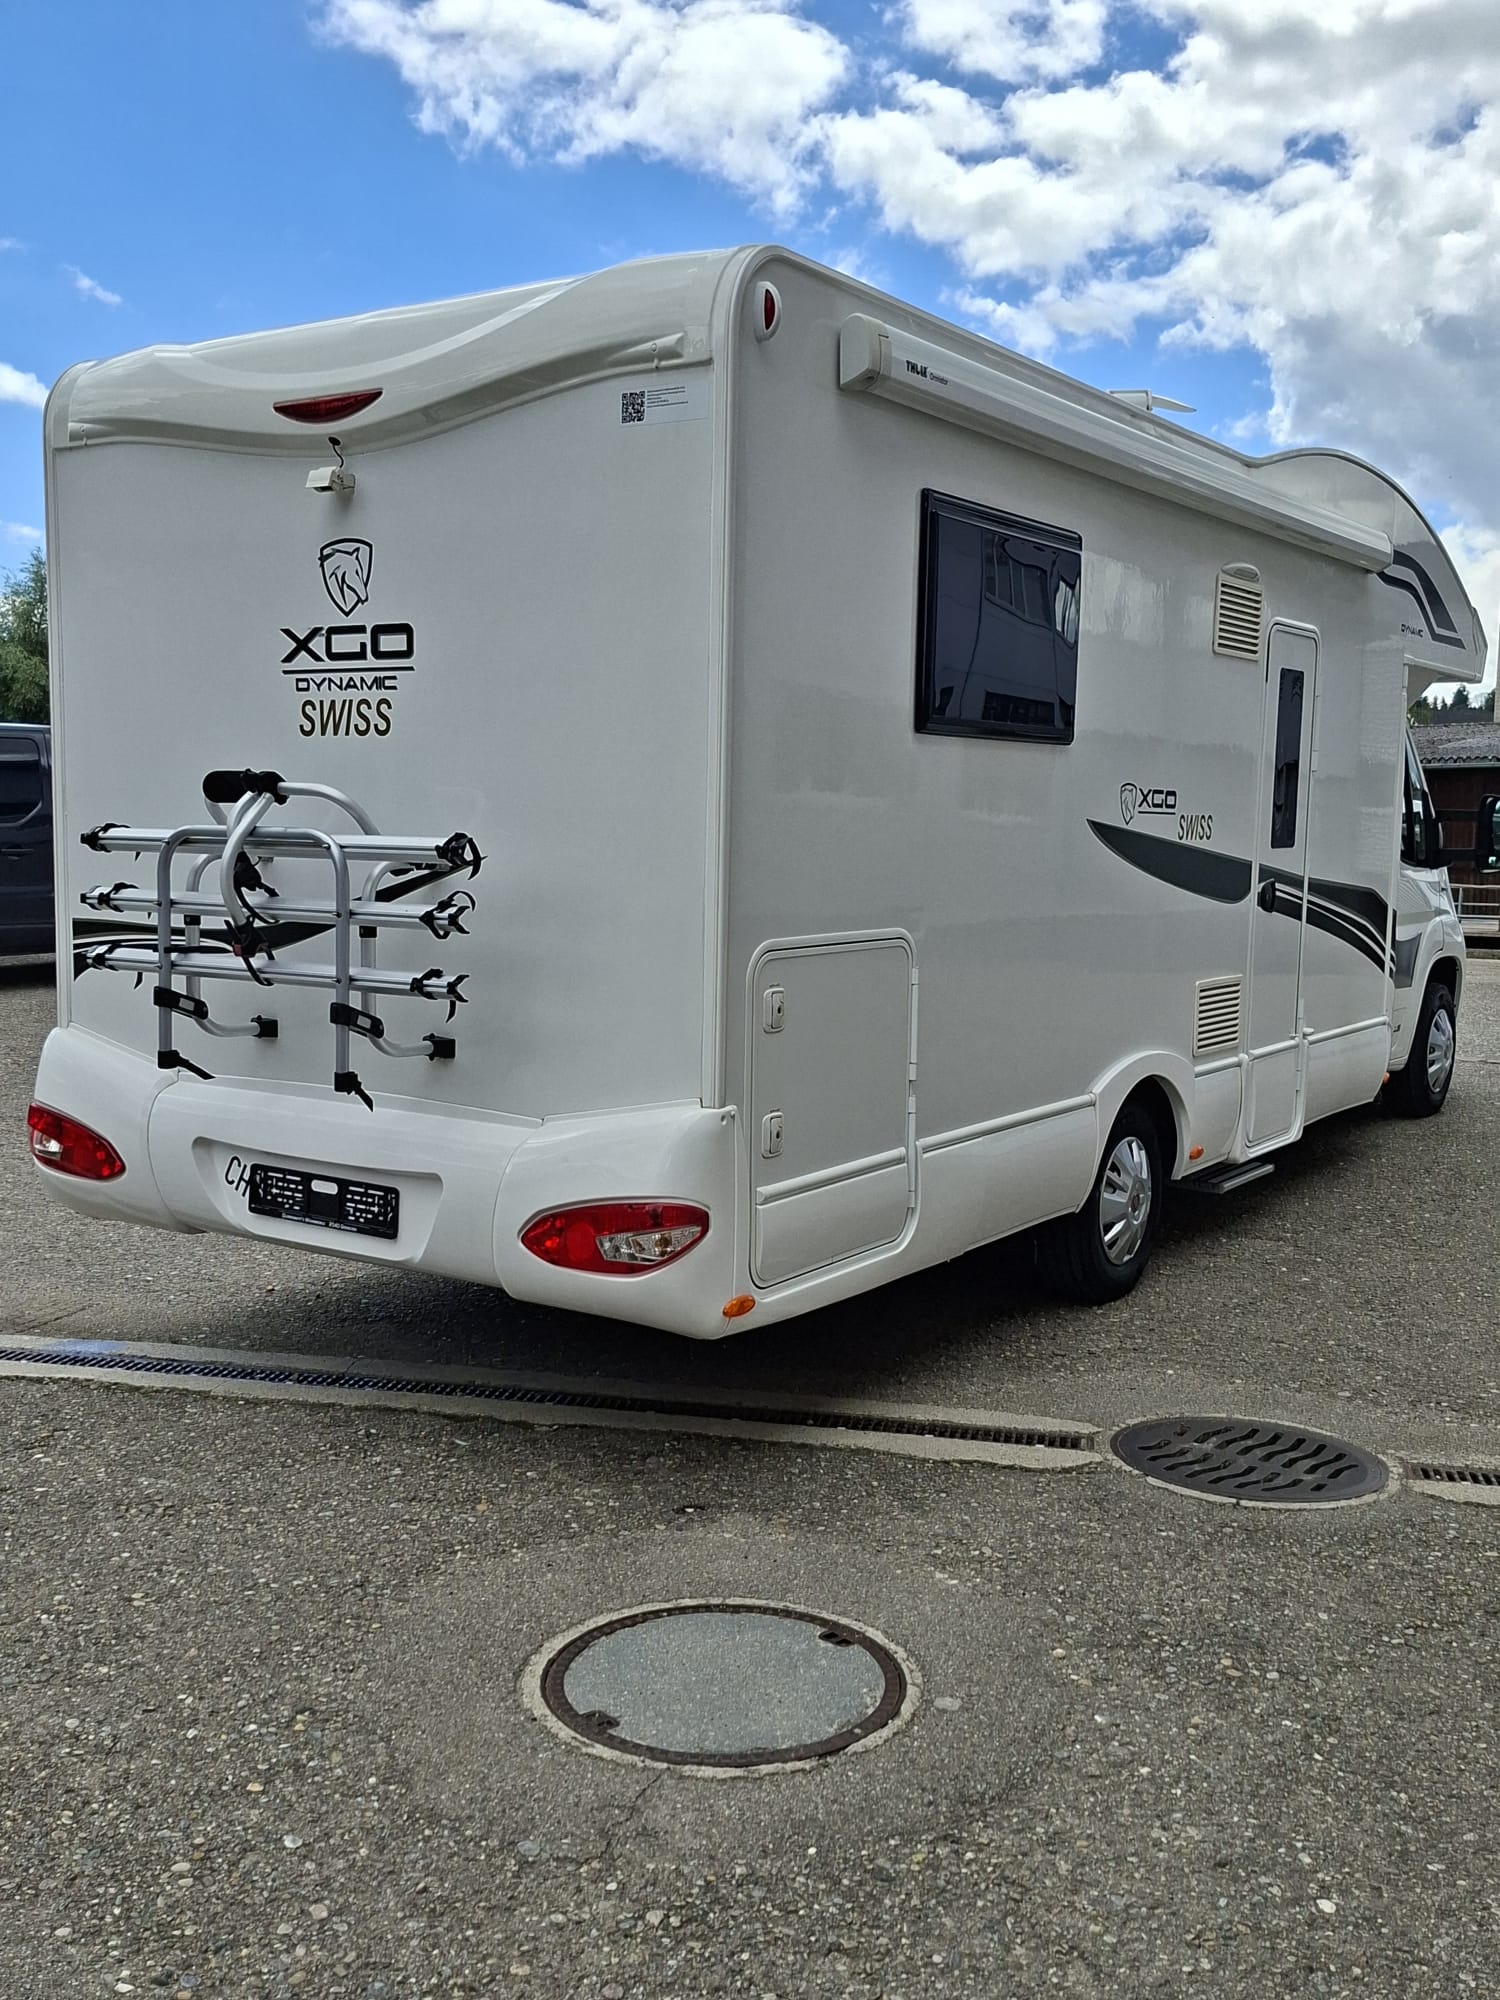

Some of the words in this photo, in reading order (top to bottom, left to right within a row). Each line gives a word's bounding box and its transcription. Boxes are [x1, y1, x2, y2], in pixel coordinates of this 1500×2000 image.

[280, 623, 415, 663] XGO
[295, 675, 398, 692] DYNAMIC
[299, 698, 392, 737] SWISS
[1138, 787, 1177, 809] XGO
[1178, 814, 1213, 840] SWISS
[225, 1155, 251, 1198] CH
